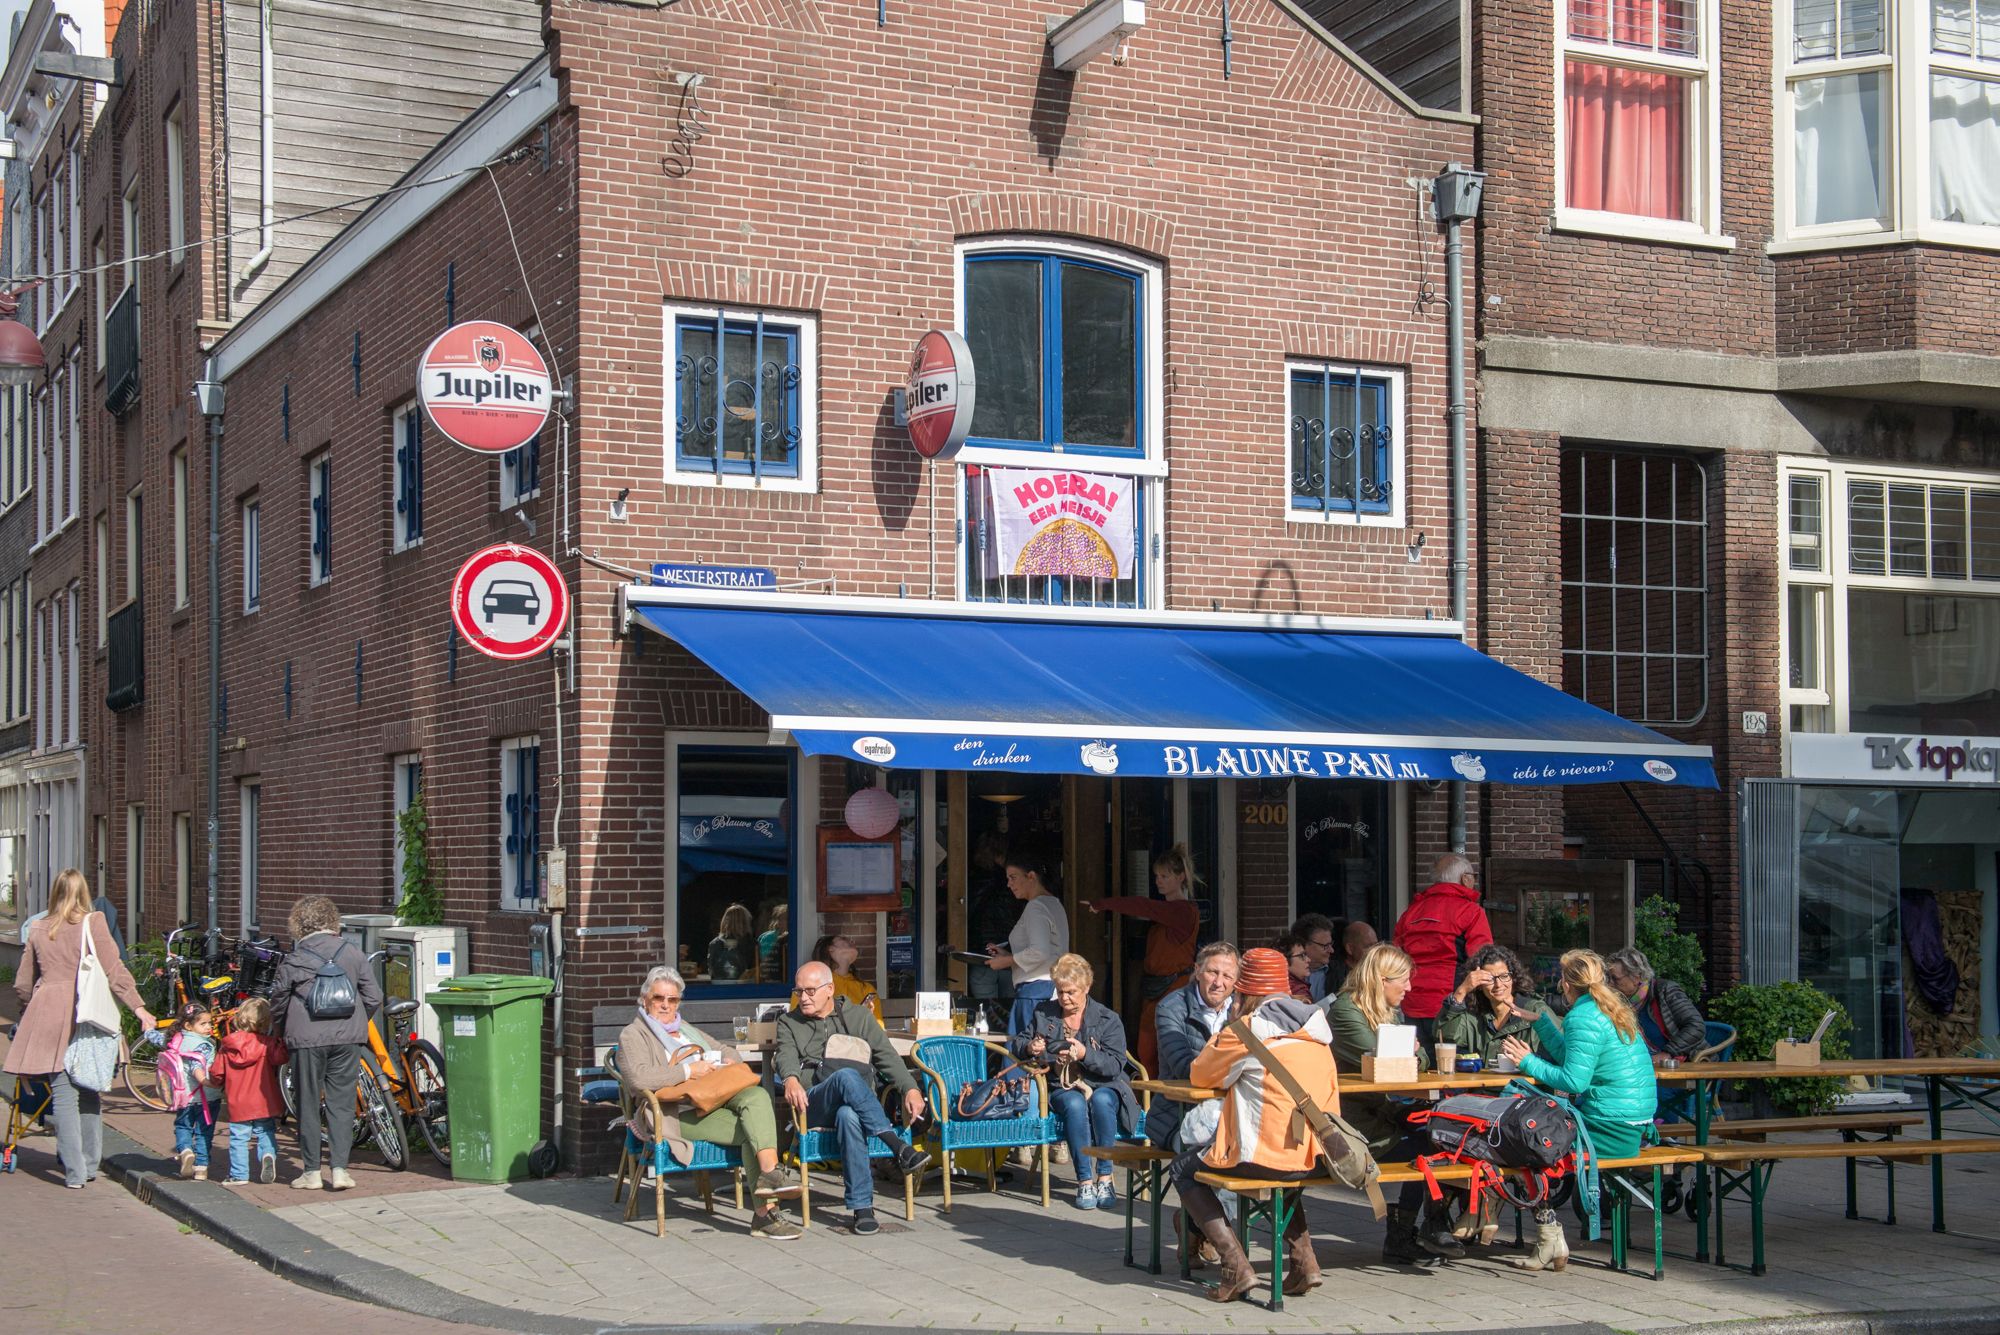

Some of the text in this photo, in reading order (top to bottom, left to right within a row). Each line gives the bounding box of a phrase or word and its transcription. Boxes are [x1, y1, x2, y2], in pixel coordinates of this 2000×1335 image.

[434, 371, 542, 405] Jupiler
[1013, 473, 1119, 513] HOERA!
[1028, 500, 1108, 528] EEN MEISJE
[661, 568, 765, 588] WESTERSTRAAT
[953, 738, 985, 752] eten
[972, 743, 1032, 767] drinken
[1864, 736, 1914, 770] TK
[1163, 745, 1319, 777] BLAUWE
[1512, 760, 1615, 780] iets te vieren?
[692, 813, 775, 841] De Blauwe Pan
[1244, 803, 1288, 825] 200
